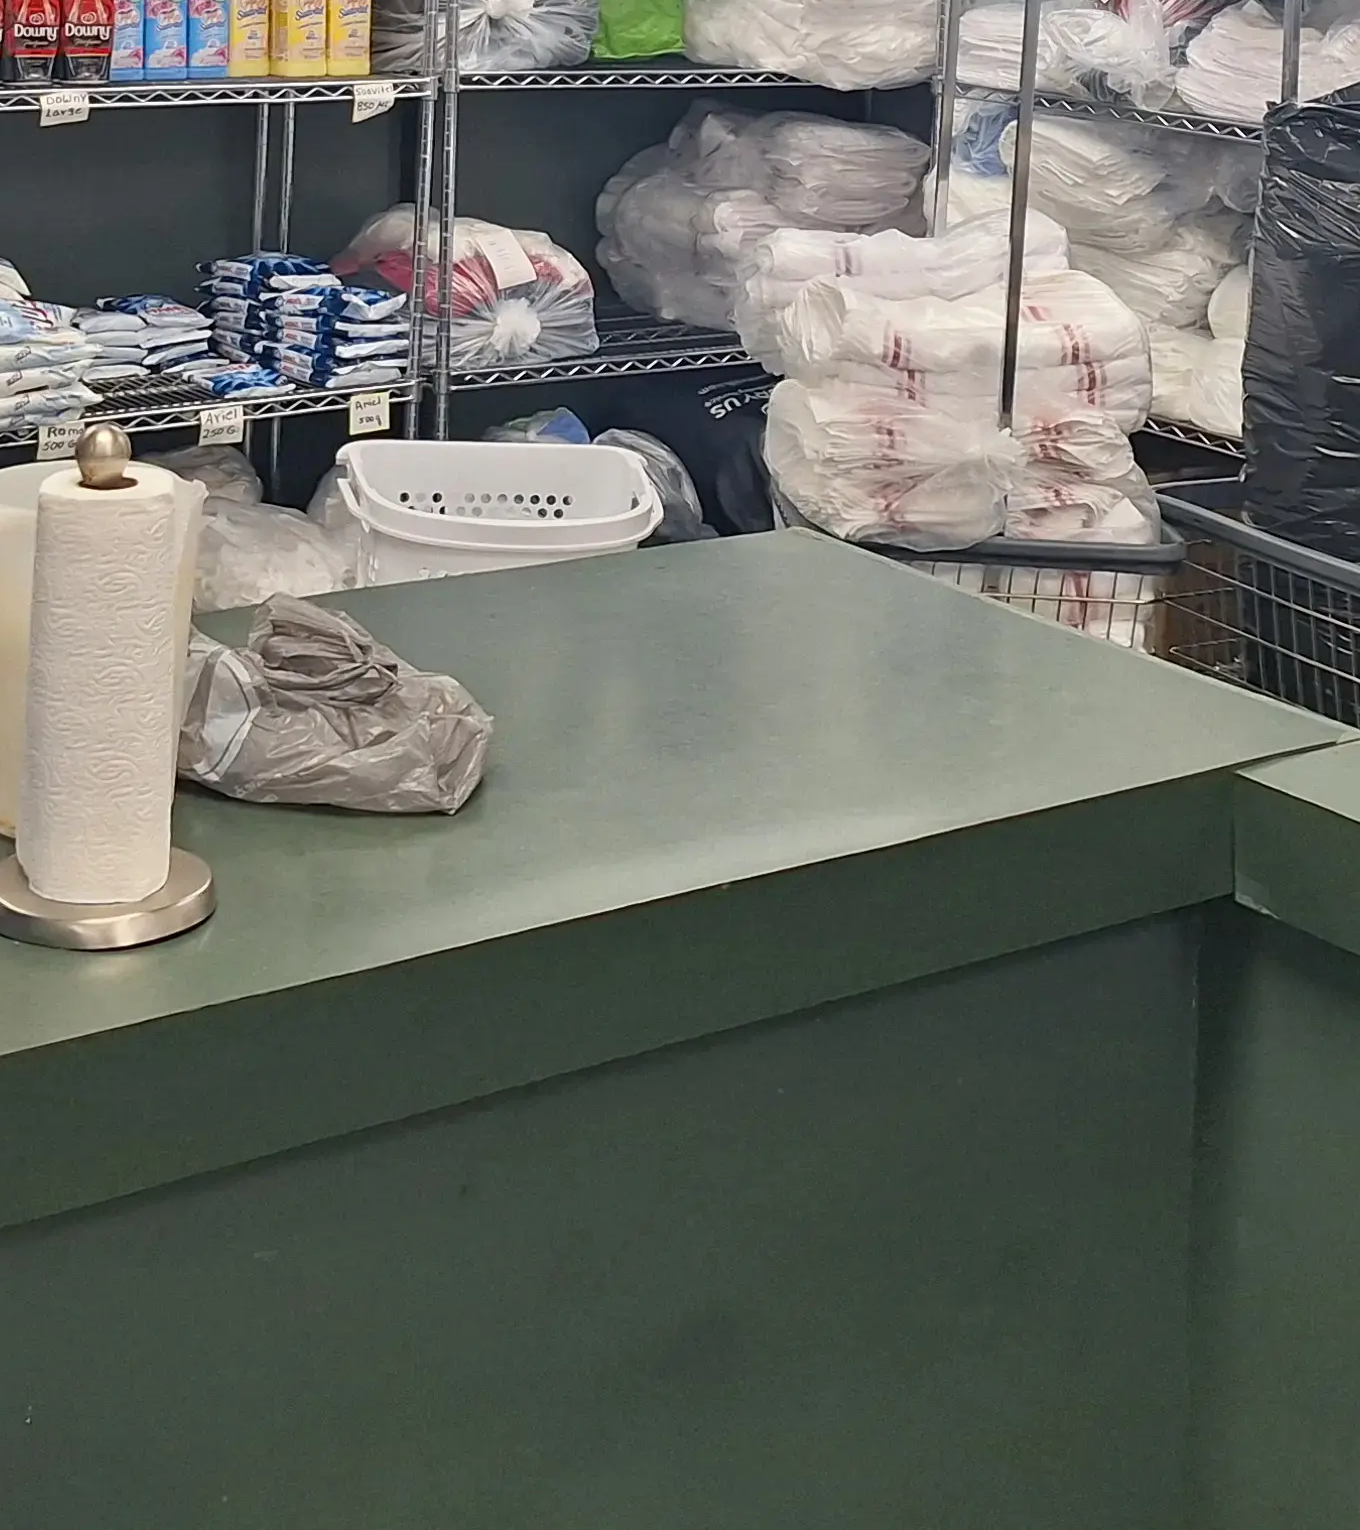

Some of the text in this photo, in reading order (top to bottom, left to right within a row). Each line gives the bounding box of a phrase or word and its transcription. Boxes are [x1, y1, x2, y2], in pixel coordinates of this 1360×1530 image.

[14, 23, 59, 41] Downy
[65, 22, 112, 41] Downy
[205, 407, 239, 426] Ariel
[708, 396, 743, 420] US
[201, 426, 225, 440] 250
[41, 441, 65, 453] 500
